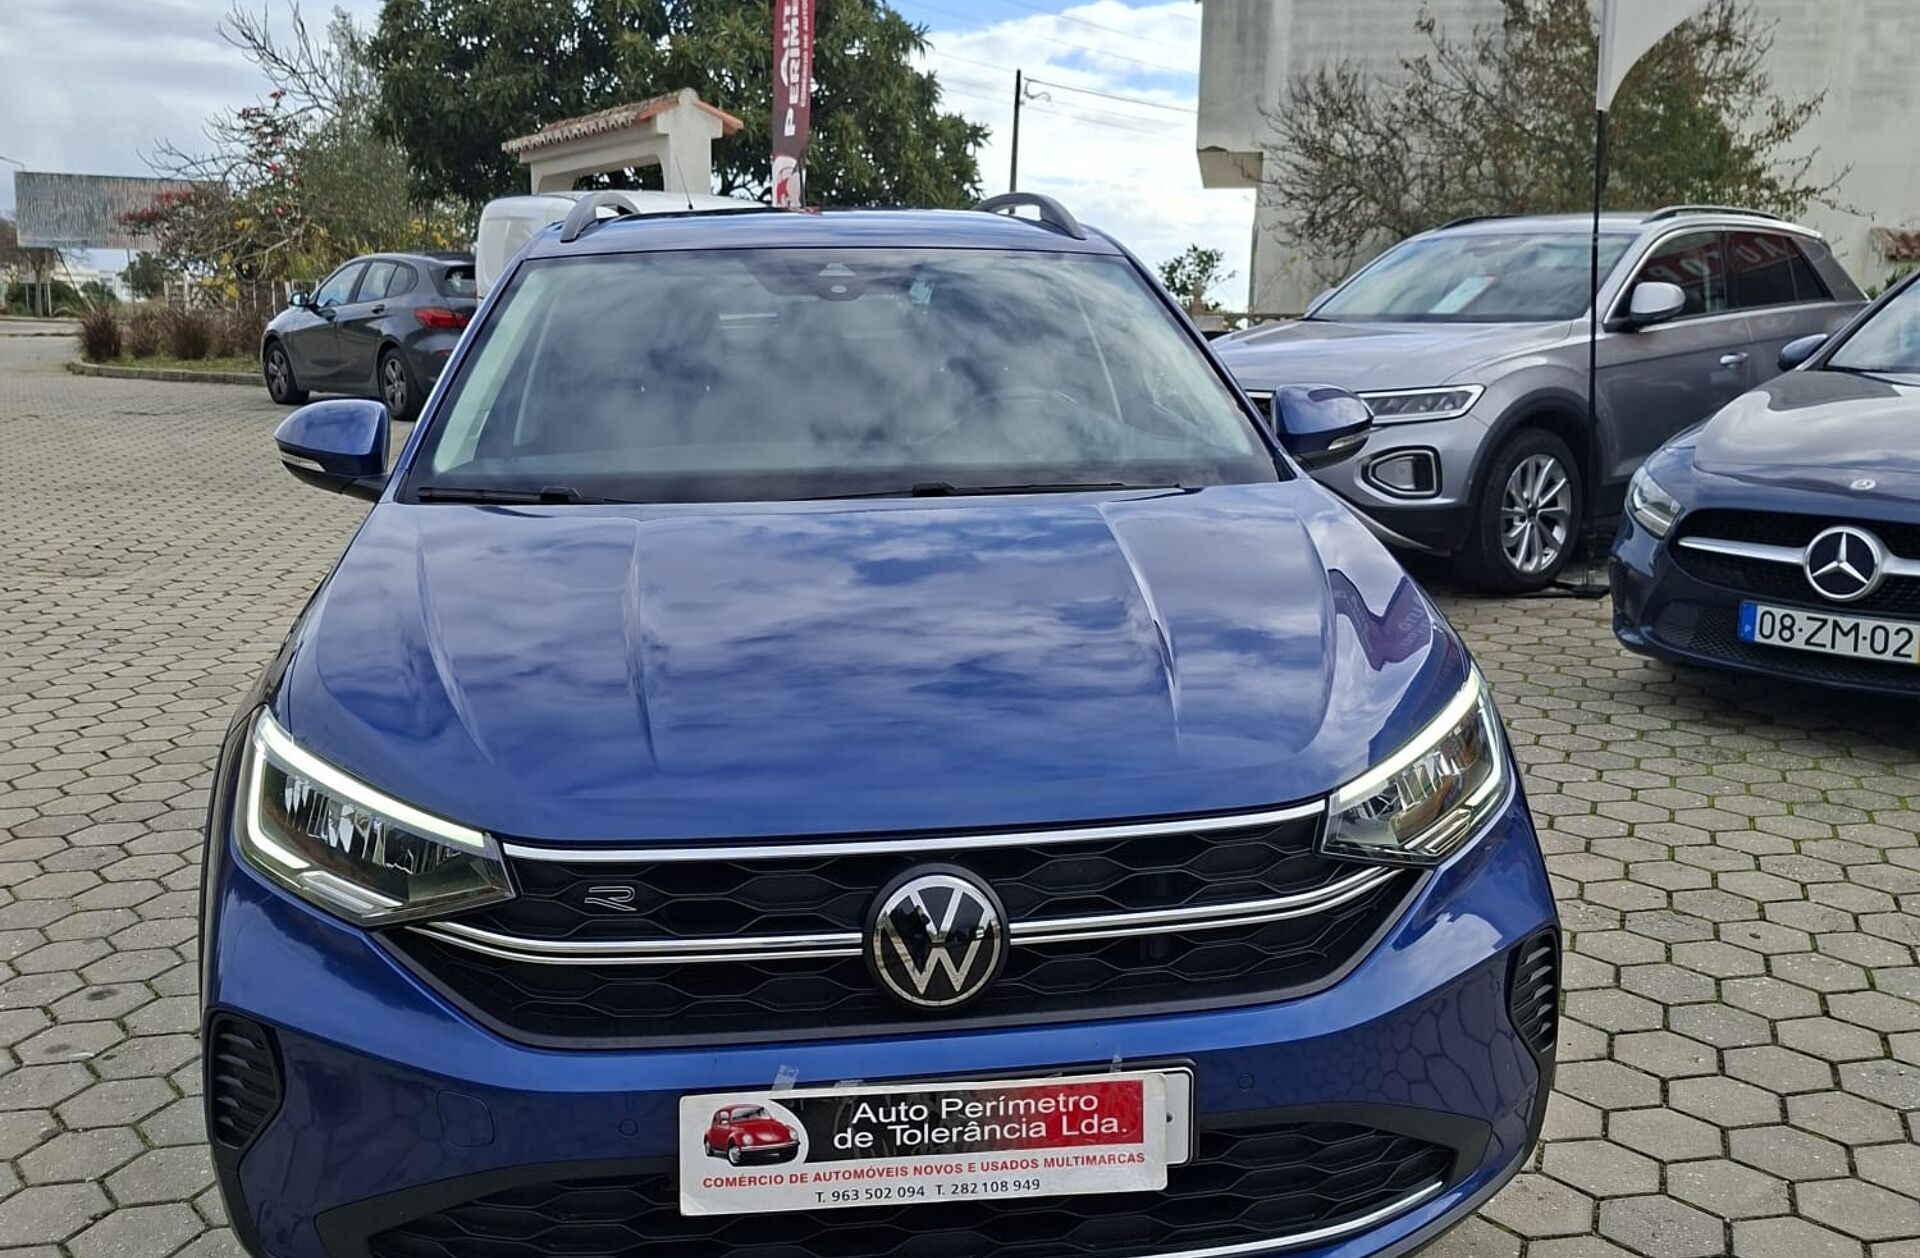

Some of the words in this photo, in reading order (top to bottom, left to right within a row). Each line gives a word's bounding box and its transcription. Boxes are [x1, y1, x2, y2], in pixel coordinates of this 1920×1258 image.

[852, 1101, 928, 1124] Auto
[941, 1093, 1098, 1120] Perímetro
[833, 1127, 874, 1149] de
[887, 1118, 1047, 1146] Tolerância
[1061, 1114, 1128, 1136] Lda.
[703, 1173, 784, 1188] COMÉRCIO
[789, 1173, 808, 1184] DE
[813, 1165, 908, 1183] AUTOMÓVEIS
[913, 1163, 963, 1176] NOVOS
[967, 1162, 977, 1173] E
[980, 1158, 1039, 1172] USADOS
[1043, 1153, 1145, 1169] MULTIMARCAS
[815, 1191, 826, 1203] T.
[831, 1189, 860, 1202] 963
[864, 1187, 892, 1200] 502
[897, 1185, 925, 1198] 094
[936, 1184, 946, 1196] T.
[951, 1183, 977, 1195] 282
[982, 1180, 1009, 1193] 108
[1013, 1178, 1040, 1192] 949
